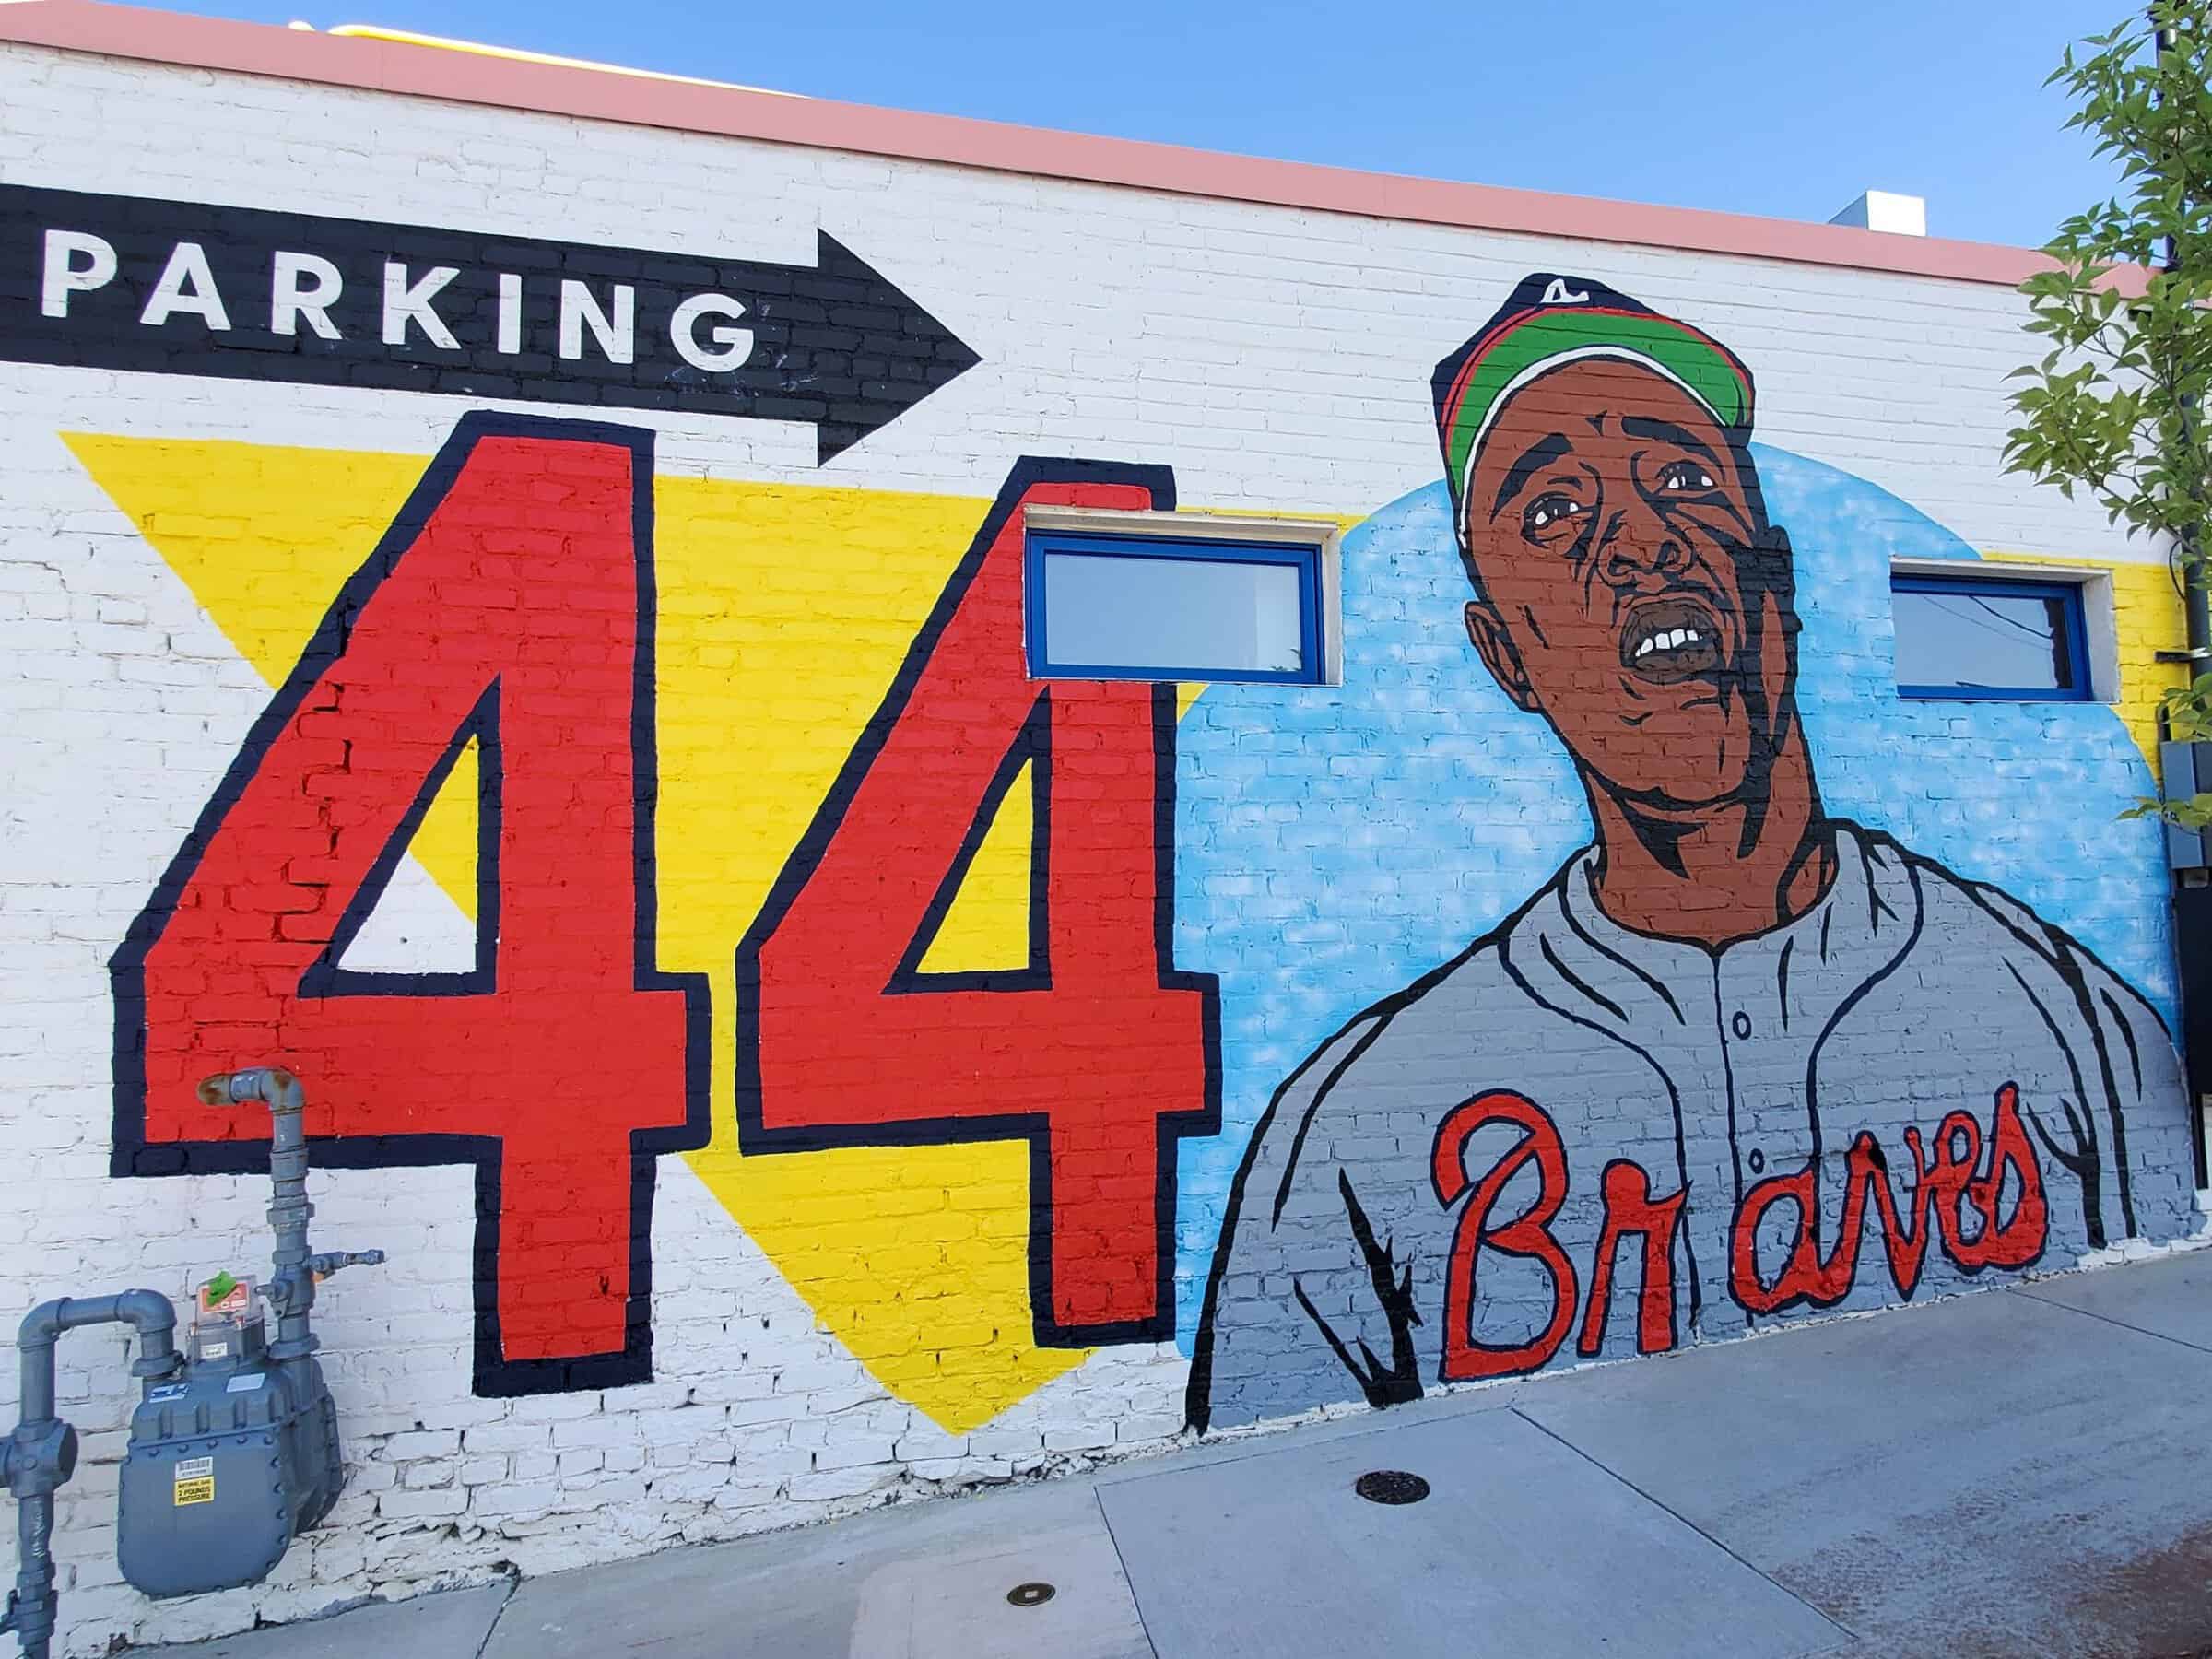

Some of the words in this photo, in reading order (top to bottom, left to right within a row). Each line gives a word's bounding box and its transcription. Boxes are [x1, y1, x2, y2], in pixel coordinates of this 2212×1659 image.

[41, 228, 755, 372] PARKING
[110, 409, 1221, 1398] 44
[1430, 1082, 2049, 1382] Braves
